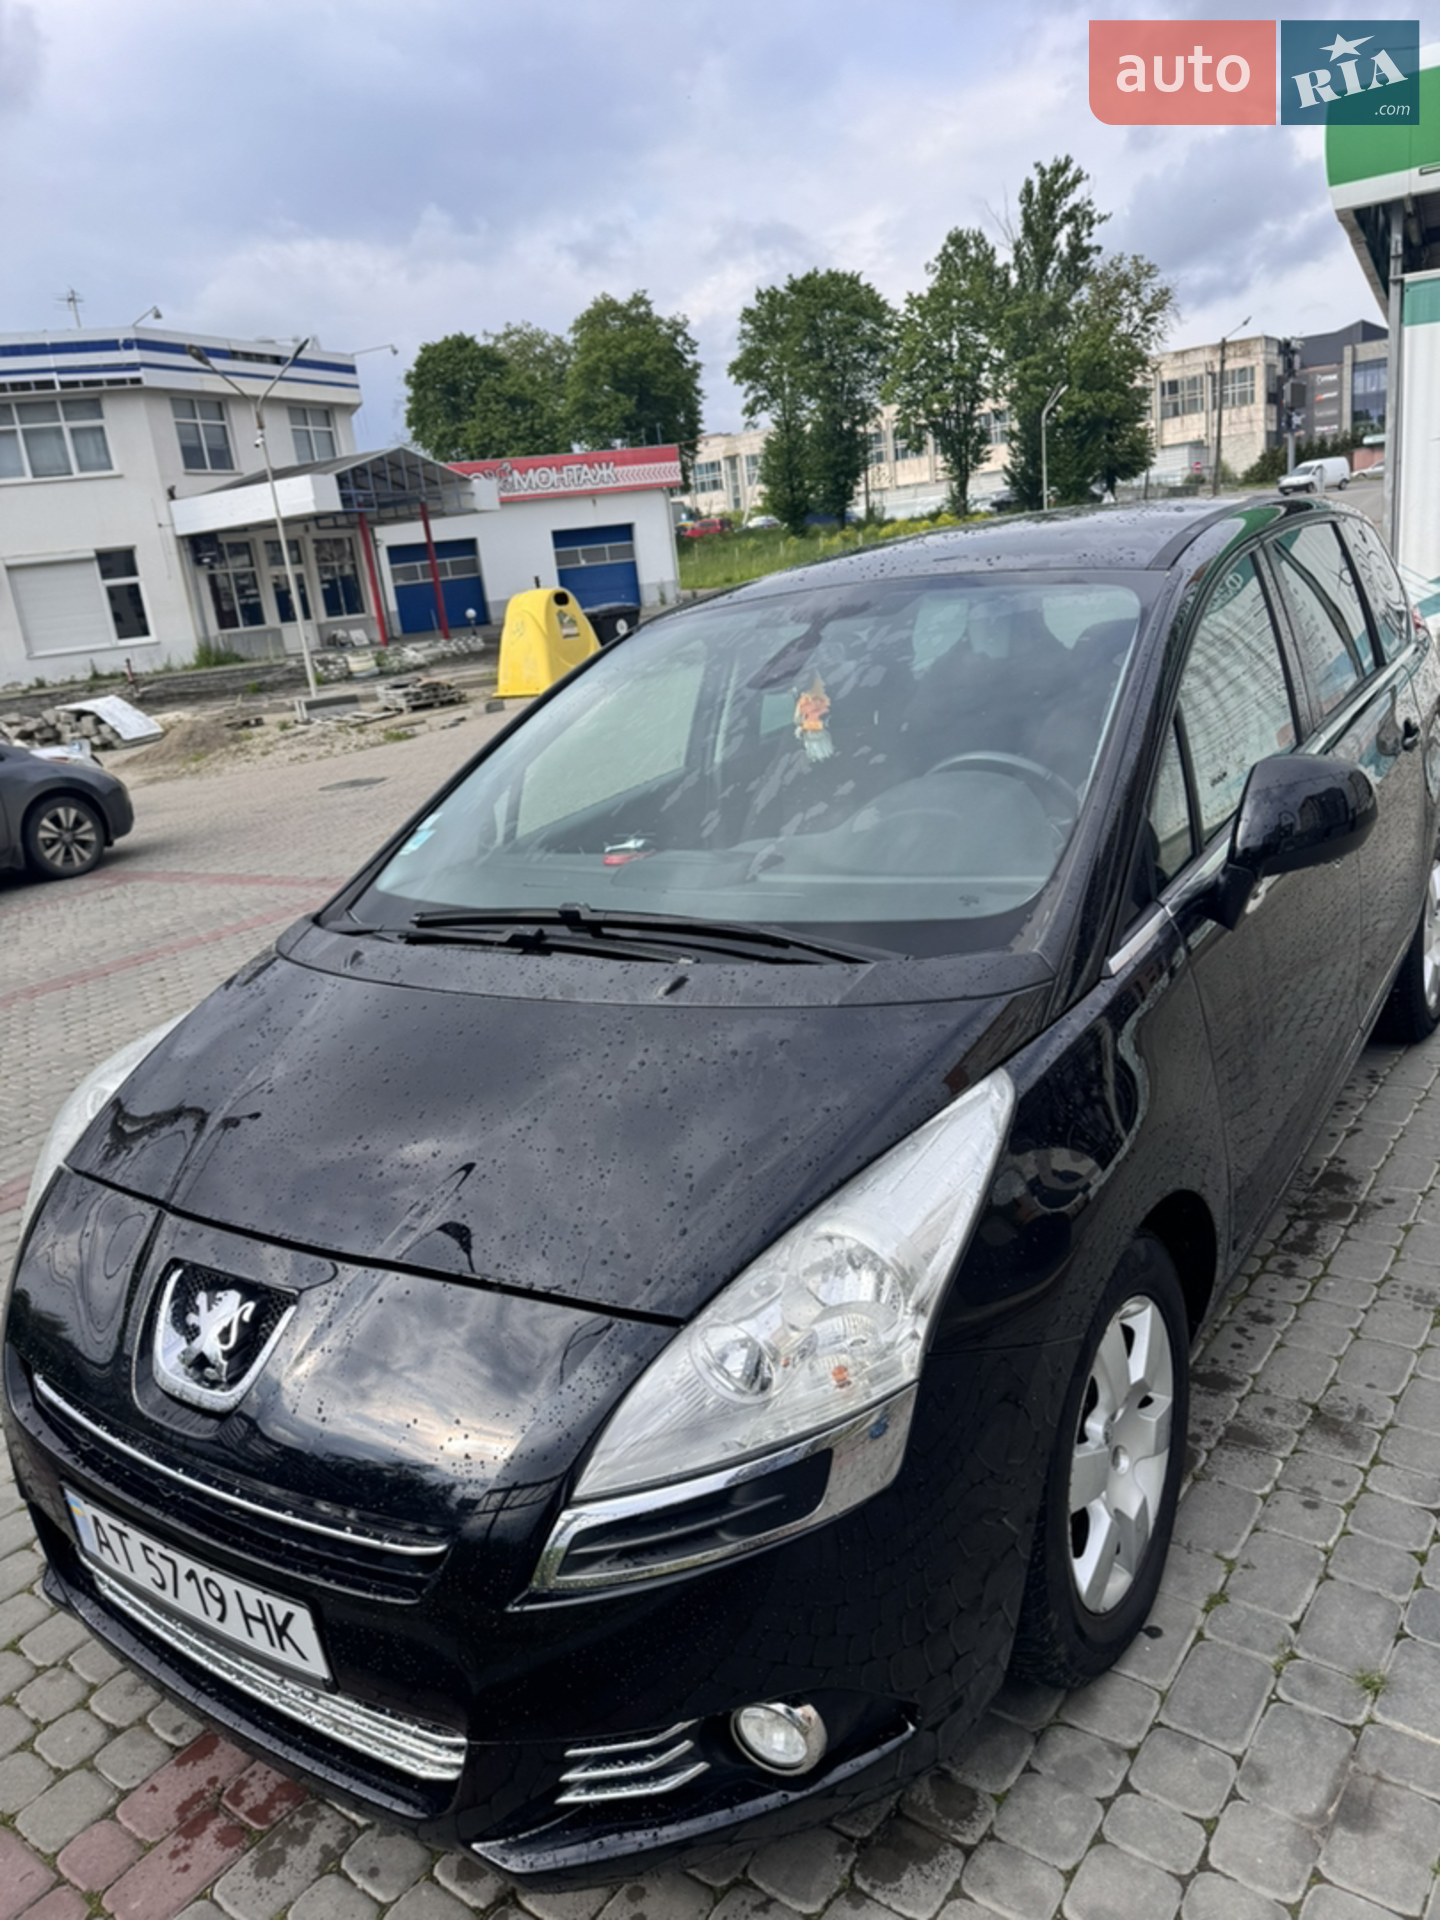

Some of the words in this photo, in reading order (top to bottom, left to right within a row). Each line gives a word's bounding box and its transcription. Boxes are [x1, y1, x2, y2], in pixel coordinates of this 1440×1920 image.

[92, 1513, 135, 1573] AT
[139, 1541, 227, 1624] 5719
[234, 1589, 310, 1663] HK
